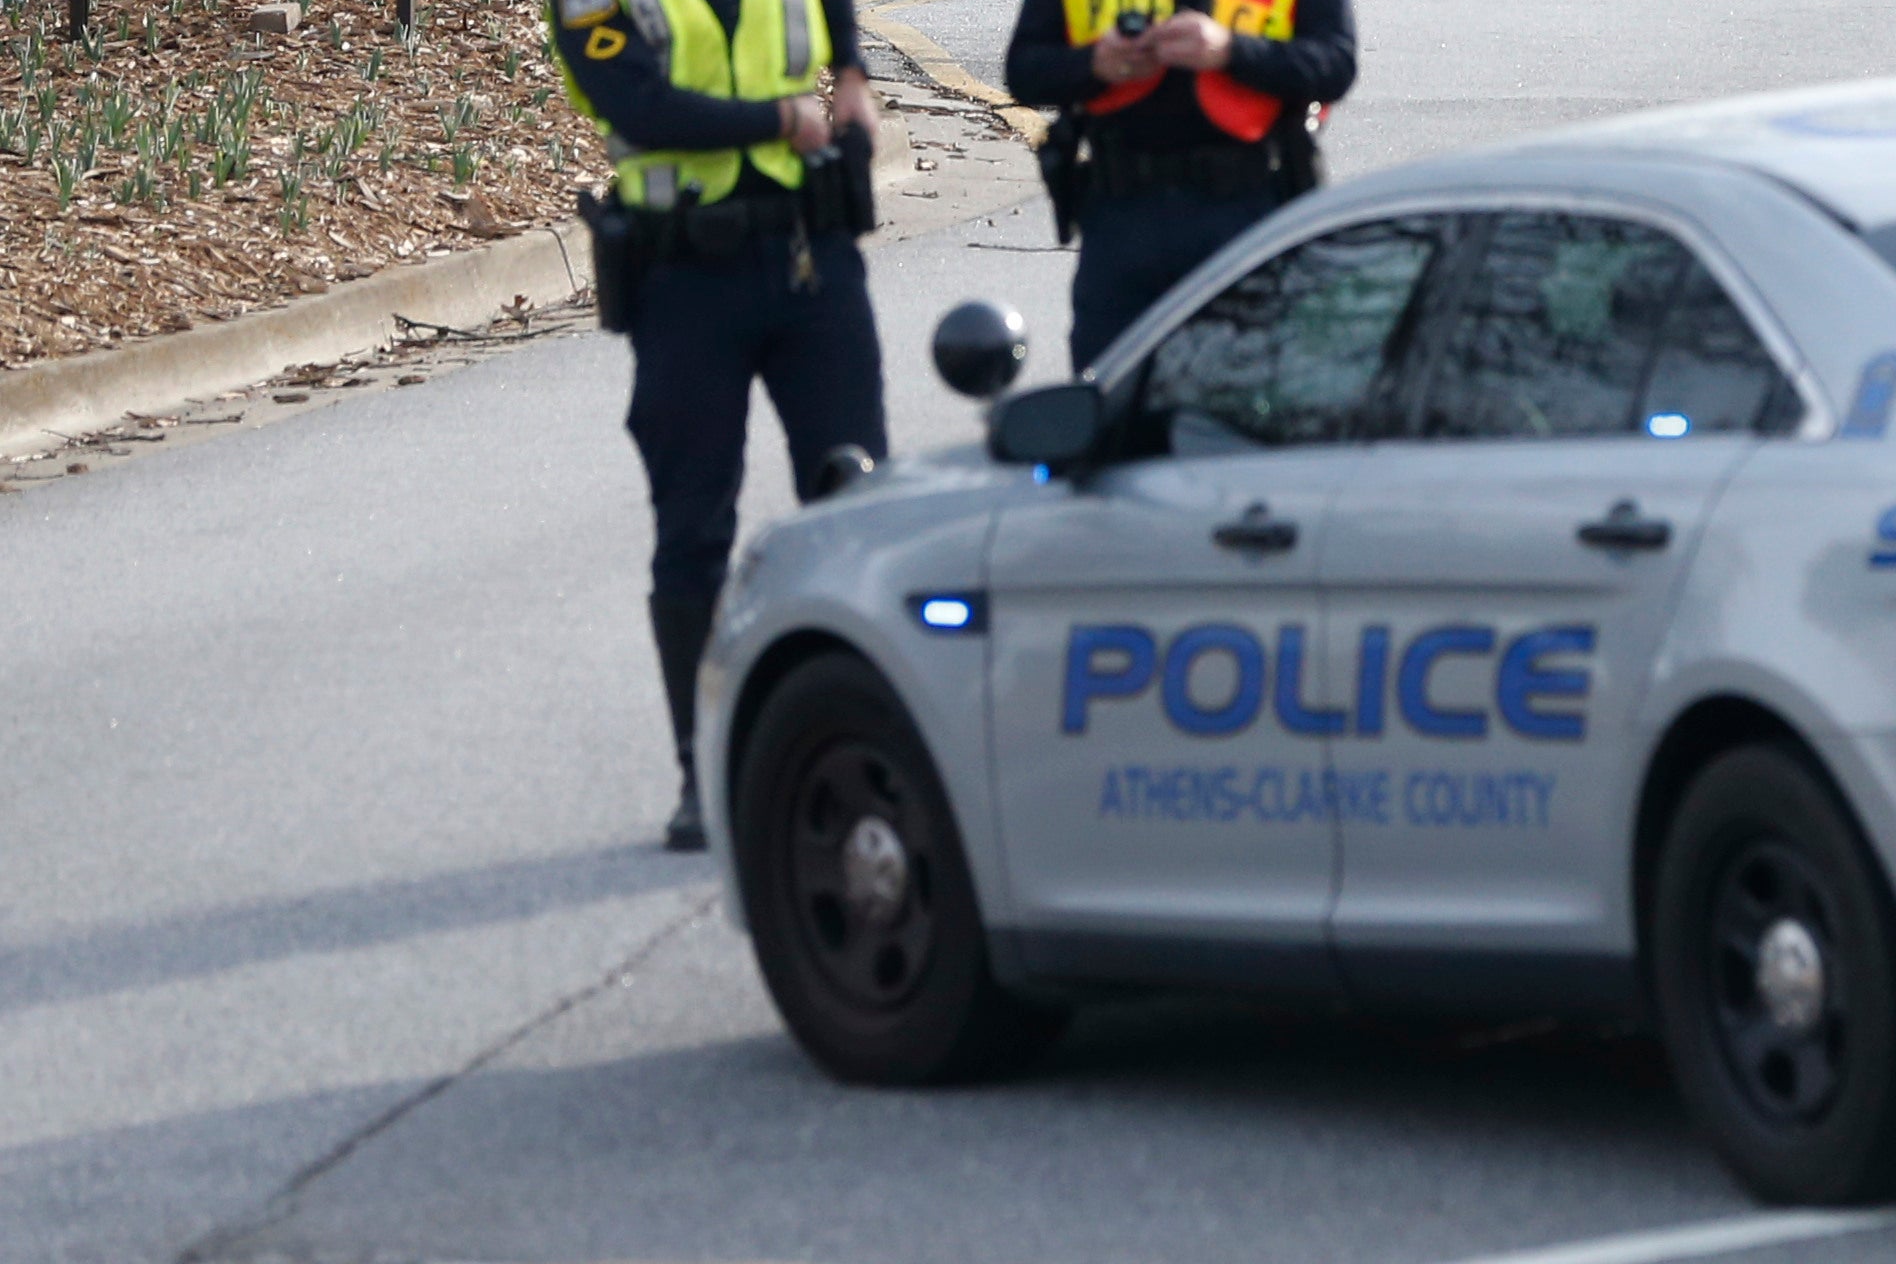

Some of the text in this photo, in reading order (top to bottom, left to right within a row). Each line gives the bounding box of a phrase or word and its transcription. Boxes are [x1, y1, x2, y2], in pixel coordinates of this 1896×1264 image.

[1059, 621, 1597, 740] POLICE
[1101, 765, 1556, 828] ATHENS-CLARKE COUNTY
